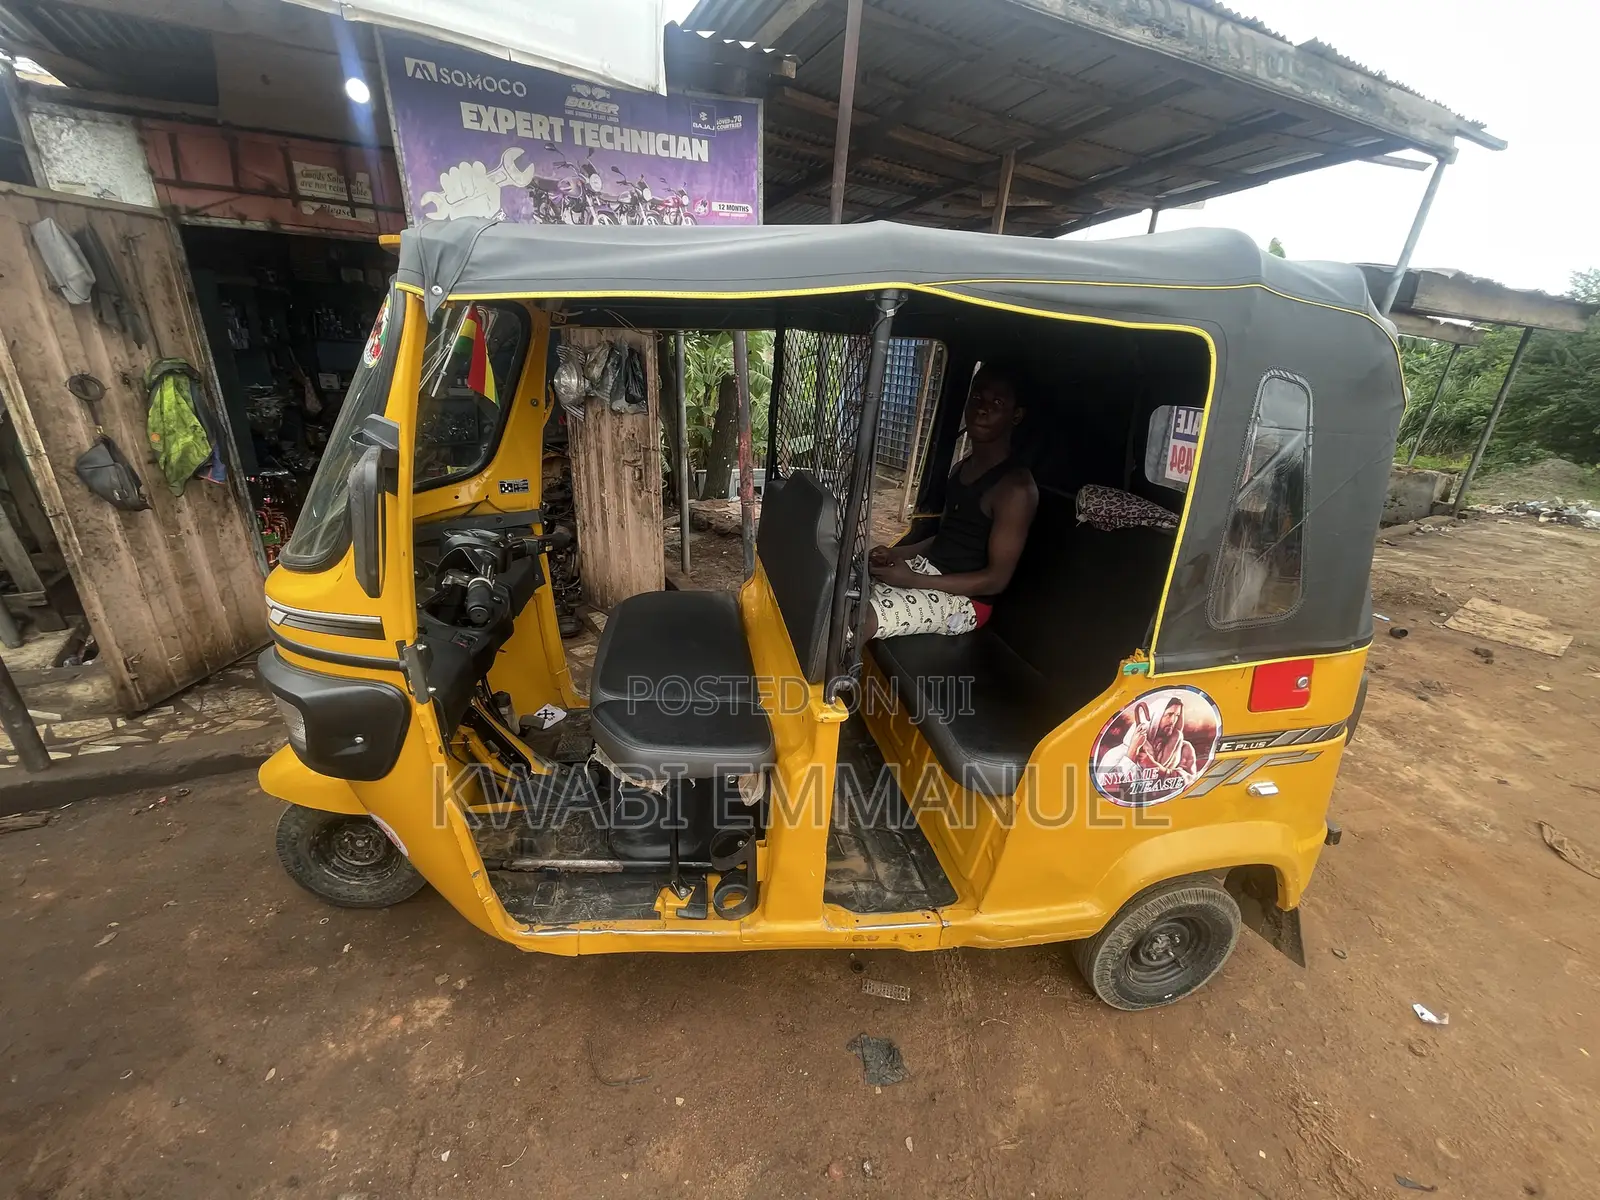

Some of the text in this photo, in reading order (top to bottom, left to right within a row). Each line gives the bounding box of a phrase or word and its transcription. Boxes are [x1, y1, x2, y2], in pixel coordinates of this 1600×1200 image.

[440, 67, 527, 97] SOMOCO
[460, 101, 709, 163] EXPERT TECHNICIAN
[692, 121, 715, 131] BAJAJ
[718, 203, 750, 213] 12 MONTHS
[1235, 741, 1267, 751] PLUS
[1129, 777, 1185, 795] TEASE
